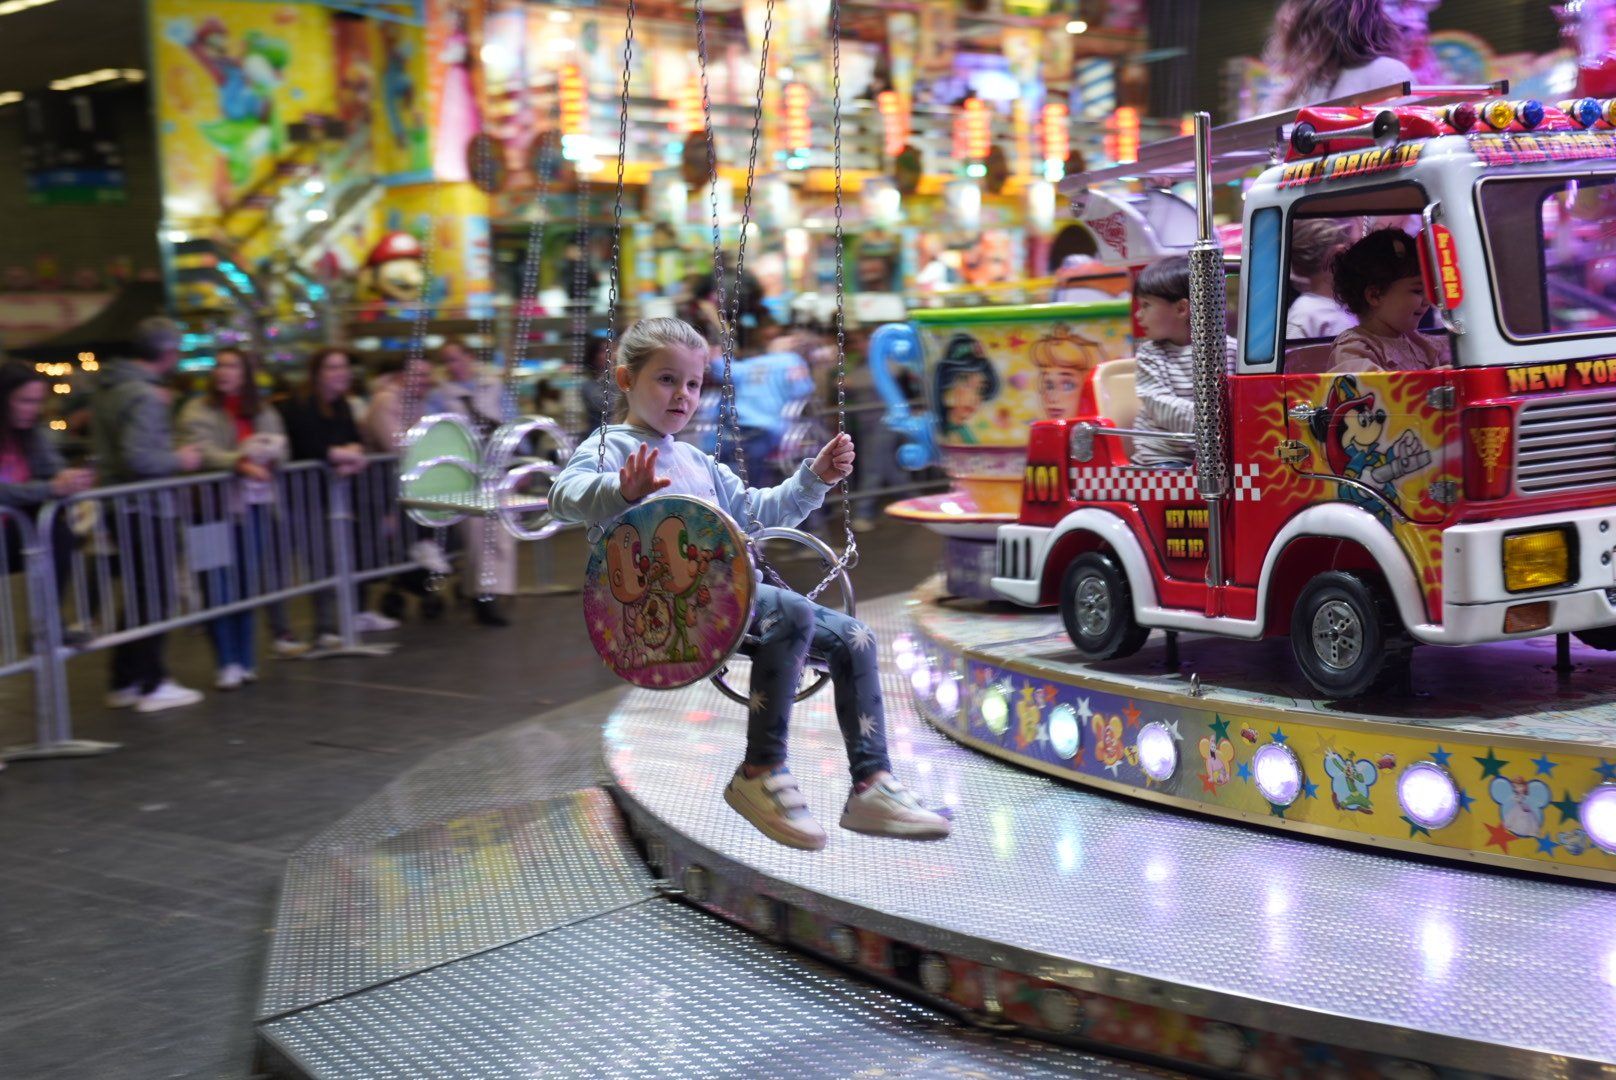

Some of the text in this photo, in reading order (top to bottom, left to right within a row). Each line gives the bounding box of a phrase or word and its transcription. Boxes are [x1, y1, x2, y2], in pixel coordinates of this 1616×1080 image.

[1436, 232, 1460, 299] FIRE
[1506, 363, 1568, 392] NEW
[1025, 465, 1059, 502] 101
[1165, 509, 1186, 529] NEW
[1166, 538, 1186, 558] FIRE
